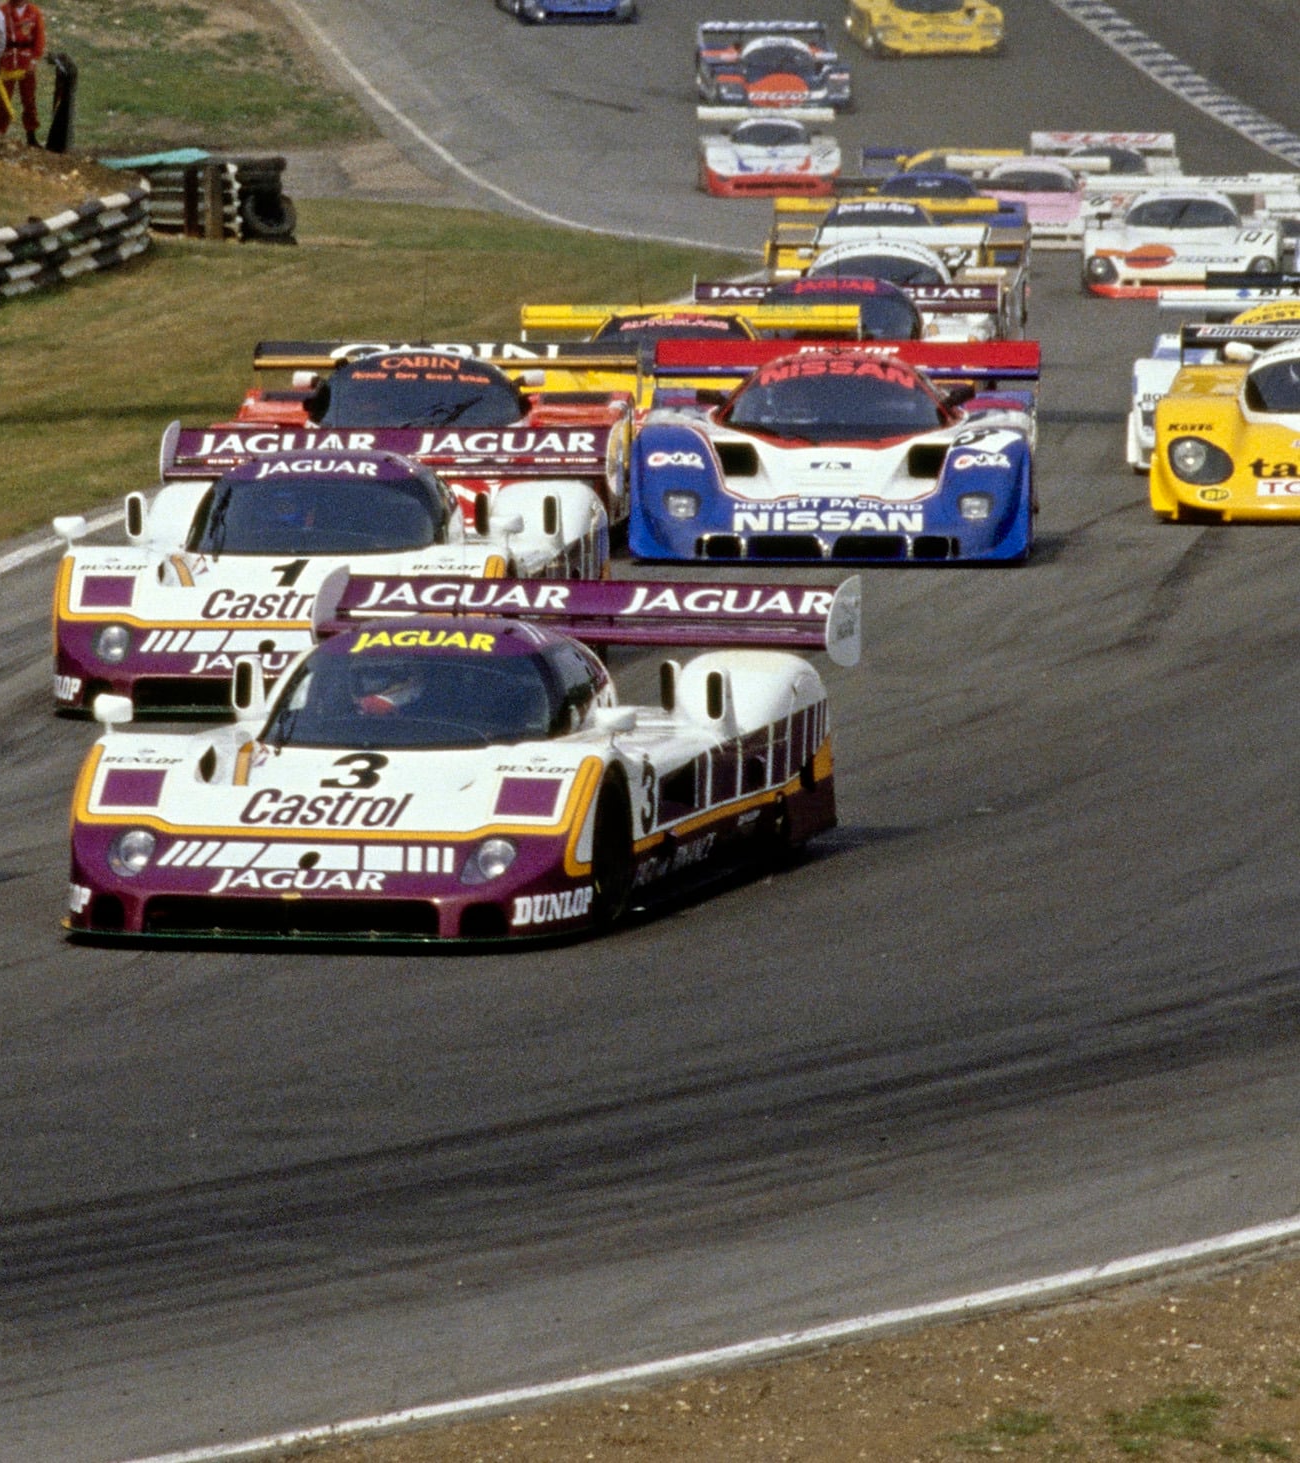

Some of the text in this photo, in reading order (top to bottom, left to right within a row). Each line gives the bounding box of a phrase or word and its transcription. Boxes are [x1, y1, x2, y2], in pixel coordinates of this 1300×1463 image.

[710, 286, 982, 300] JAG GUAR
[330, 343, 560, 359] CIN
[380, 355, 462, 371] CABIN
[760, 361, 915, 390] NISSAN
[195, 431, 596, 457] JAGUAR JAGUAR
[256, 459, 379, 480] JAGUAR
[733, 498, 924, 512] HEWLETT PACKARD
[733, 511, 924, 533] NISSAN
[271, 559, 311, 588] 1
[200, 588, 316, 620] Castr
[355, 581, 834, 615] JAGUAR JAGUAR
[349, 630, 496, 653] JAGUAR
[320, 752, 390, 790] 3
[238, 787, 414, 828] Castrol
[208, 868, 387, 894] JAGUAR
[511, 885, 594, 927] DUNLOP
